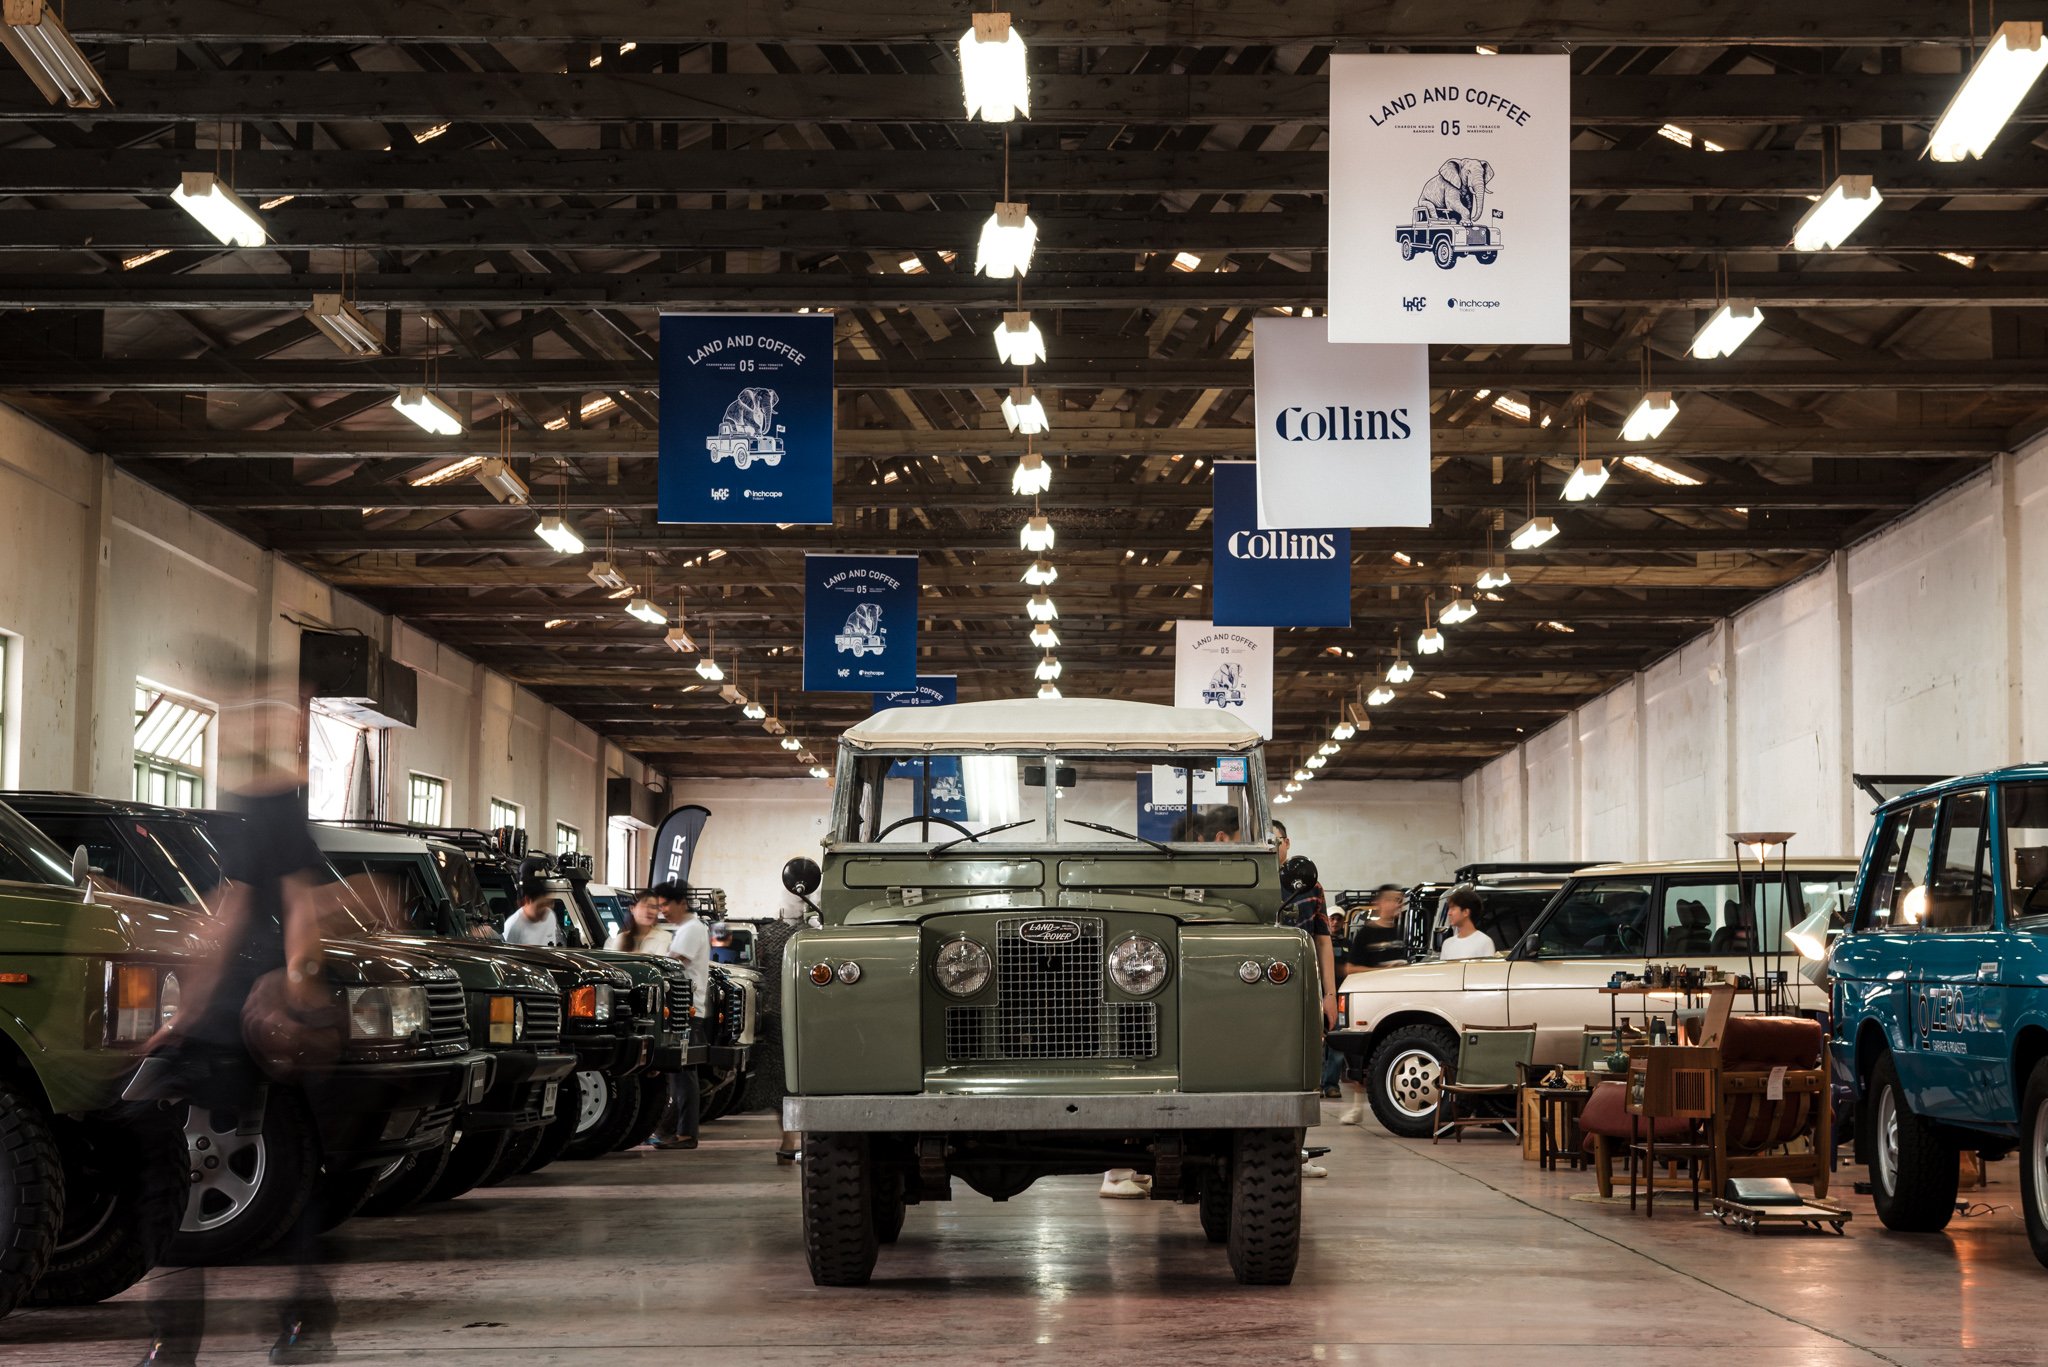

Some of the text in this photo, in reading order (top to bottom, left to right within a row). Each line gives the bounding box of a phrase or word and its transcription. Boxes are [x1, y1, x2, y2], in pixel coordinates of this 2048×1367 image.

[1369, 86, 1531, 127] LAND AND COFFEE
[1440, 120, 1460, 135] 05
[1459, 299, 1500, 308] inchcape
[687, 335, 806, 365] LAND AND COFFEE
[739, 359, 754, 372] 05
[1276, 406, 1411, 441] Collins
[752, 490, 783, 498] inchcape
[1228, 531, 1336, 560] Collins
[823, 569, 901, 590] LAND AND COFFEE
[856, 585, 867, 594] 05
[1192, 635, 1212, 650] LAND
[1230, 634, 1258, 651] COFFEE
[920, 686, 944, 702] COFFEE
[1029, 923, 1055, 931] LAND
[1042, 932, 1072, 940] ROVER
